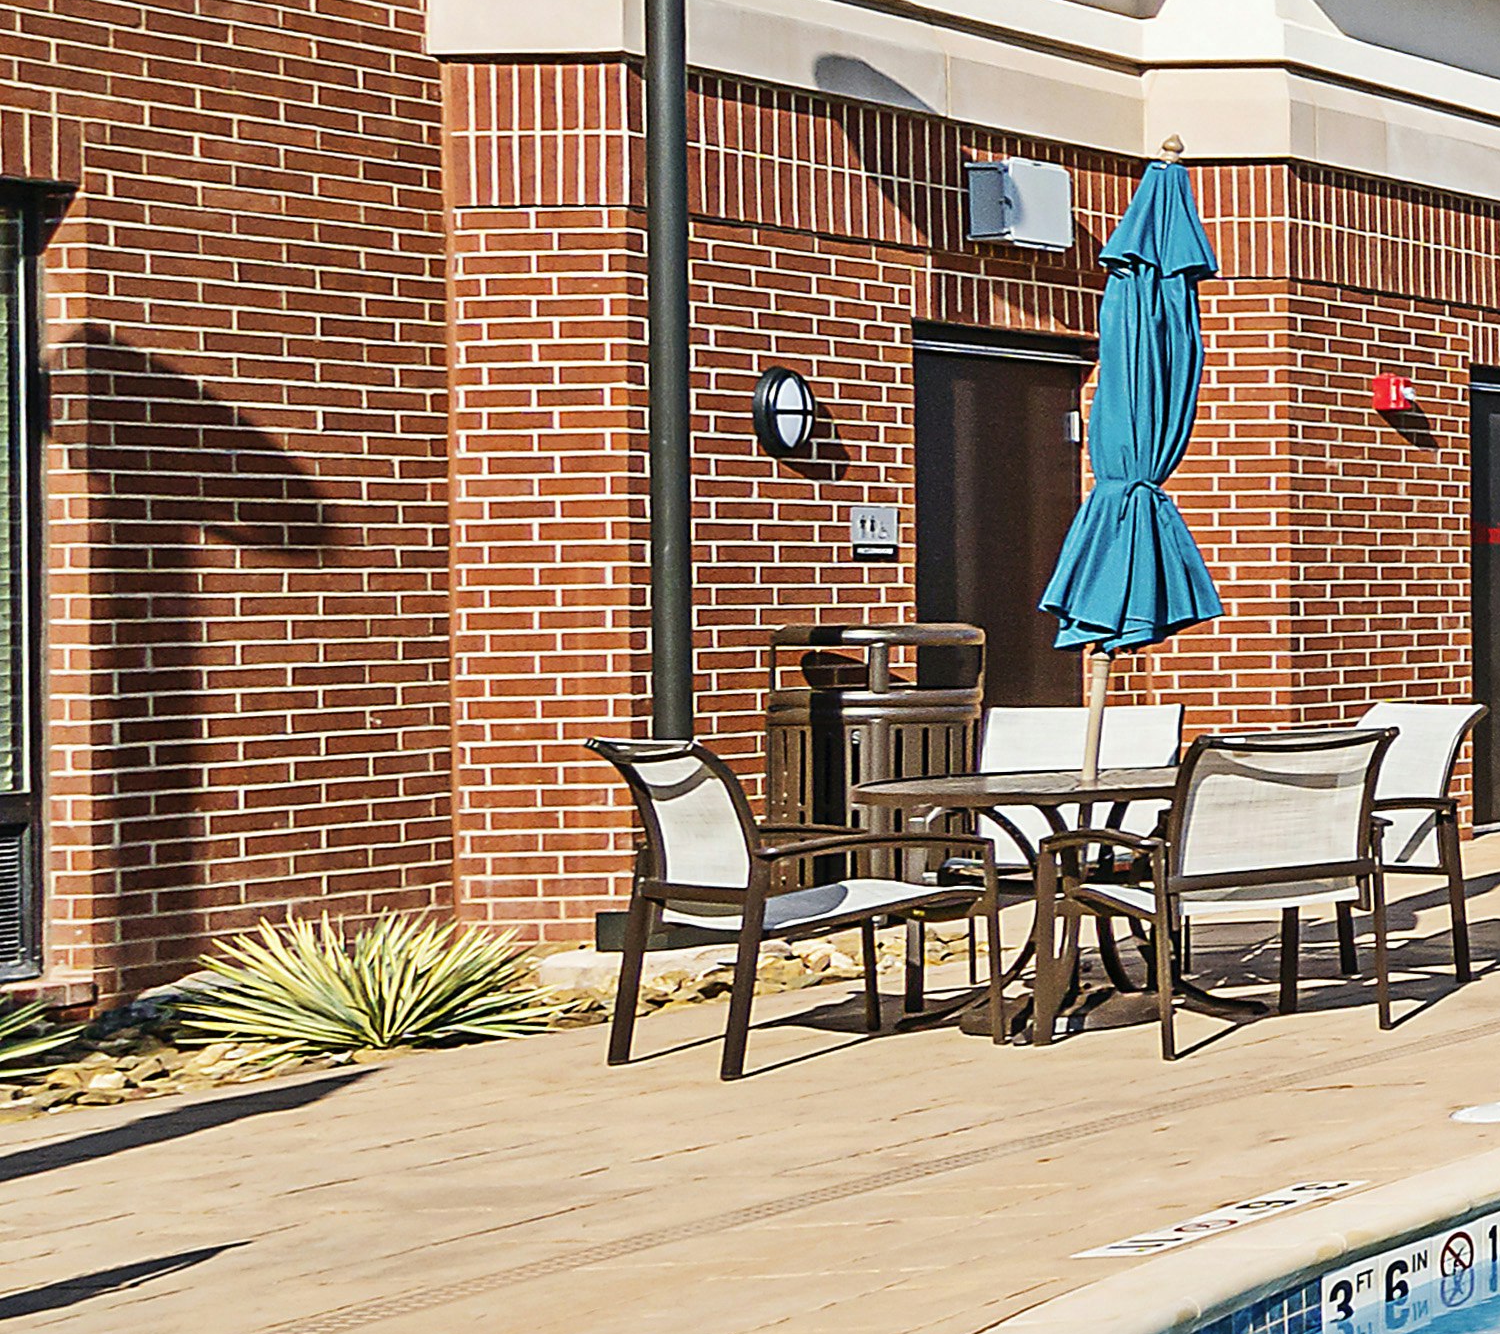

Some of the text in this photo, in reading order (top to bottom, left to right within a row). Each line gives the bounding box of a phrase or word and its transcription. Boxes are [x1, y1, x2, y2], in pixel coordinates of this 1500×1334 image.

[1329, 1279, 1355, 1323] 3
[1356, 1269, 1374, 1293] FT
[1385, 1259, 1409, 1303] 6
[1412, 1250, 1428, 1272] IN
